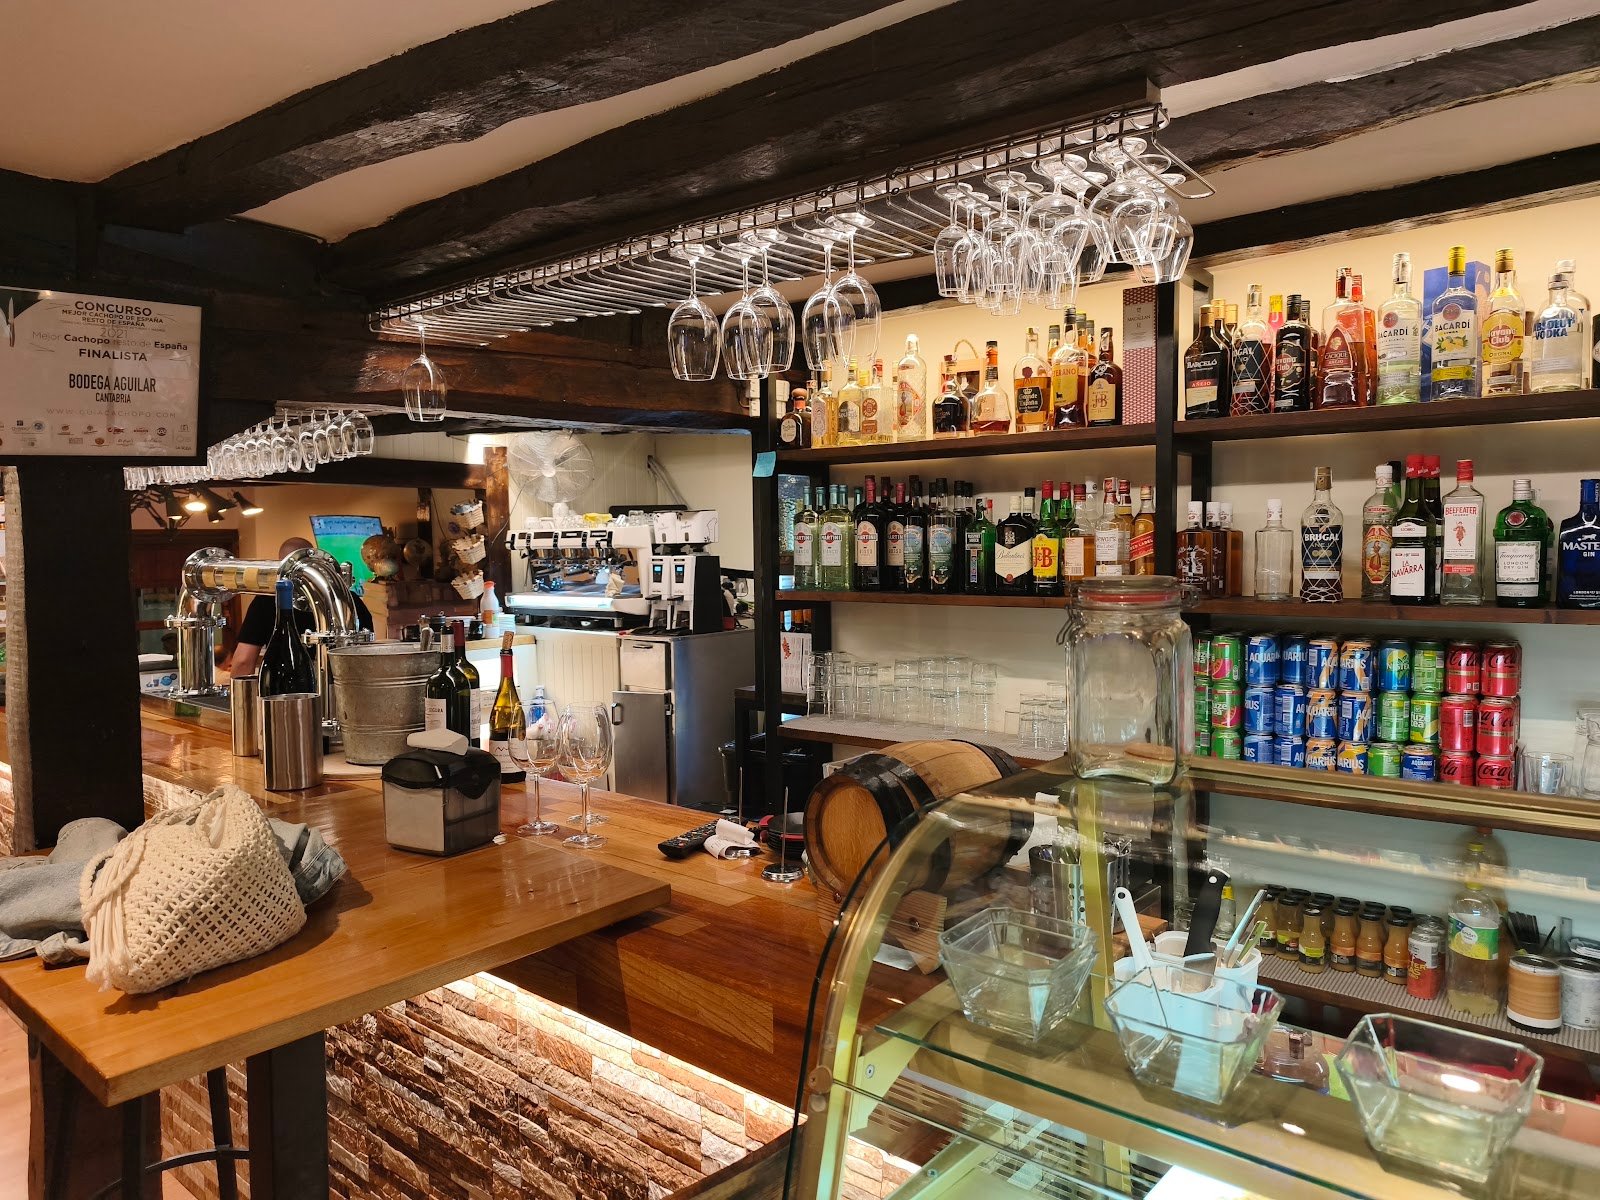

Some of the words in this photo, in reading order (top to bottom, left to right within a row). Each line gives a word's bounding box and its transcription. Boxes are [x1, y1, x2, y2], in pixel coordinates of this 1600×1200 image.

[75, 301, 152, 316] CONCURSO
[62, 309, 87, 317] MEJOR
[89, 312, 123, 320] CACHOPO
[137, 315, 163, 324] ESPAÑA
[118, 319, 145, 328] ESPAÑA
[1435, 320, 1470, 332] BACARDÍ
[100, 328, 128, 339] 2021
[1535, 328, 1568, 340] VODKA
[64, 334, 110, 347] Cachopo
[154, 341, 188, 351] España
[1491, 336, 1510, 345] Club
[79, 349, 148, 362] FINALISTA
[1187, 359, 1217, 369] BARCELÓ
[69, 374, 111, 391] BODEGA
[114, 376, 156, 393] AGUILAR
[95, 393, 131, 404] CANTABRIA
[1445, 506, 1477, 515] BEEFEATER
[1304, 533, 1339, 541] BRUGAL
[1391, 564, 1424, 578] NAVARRA
